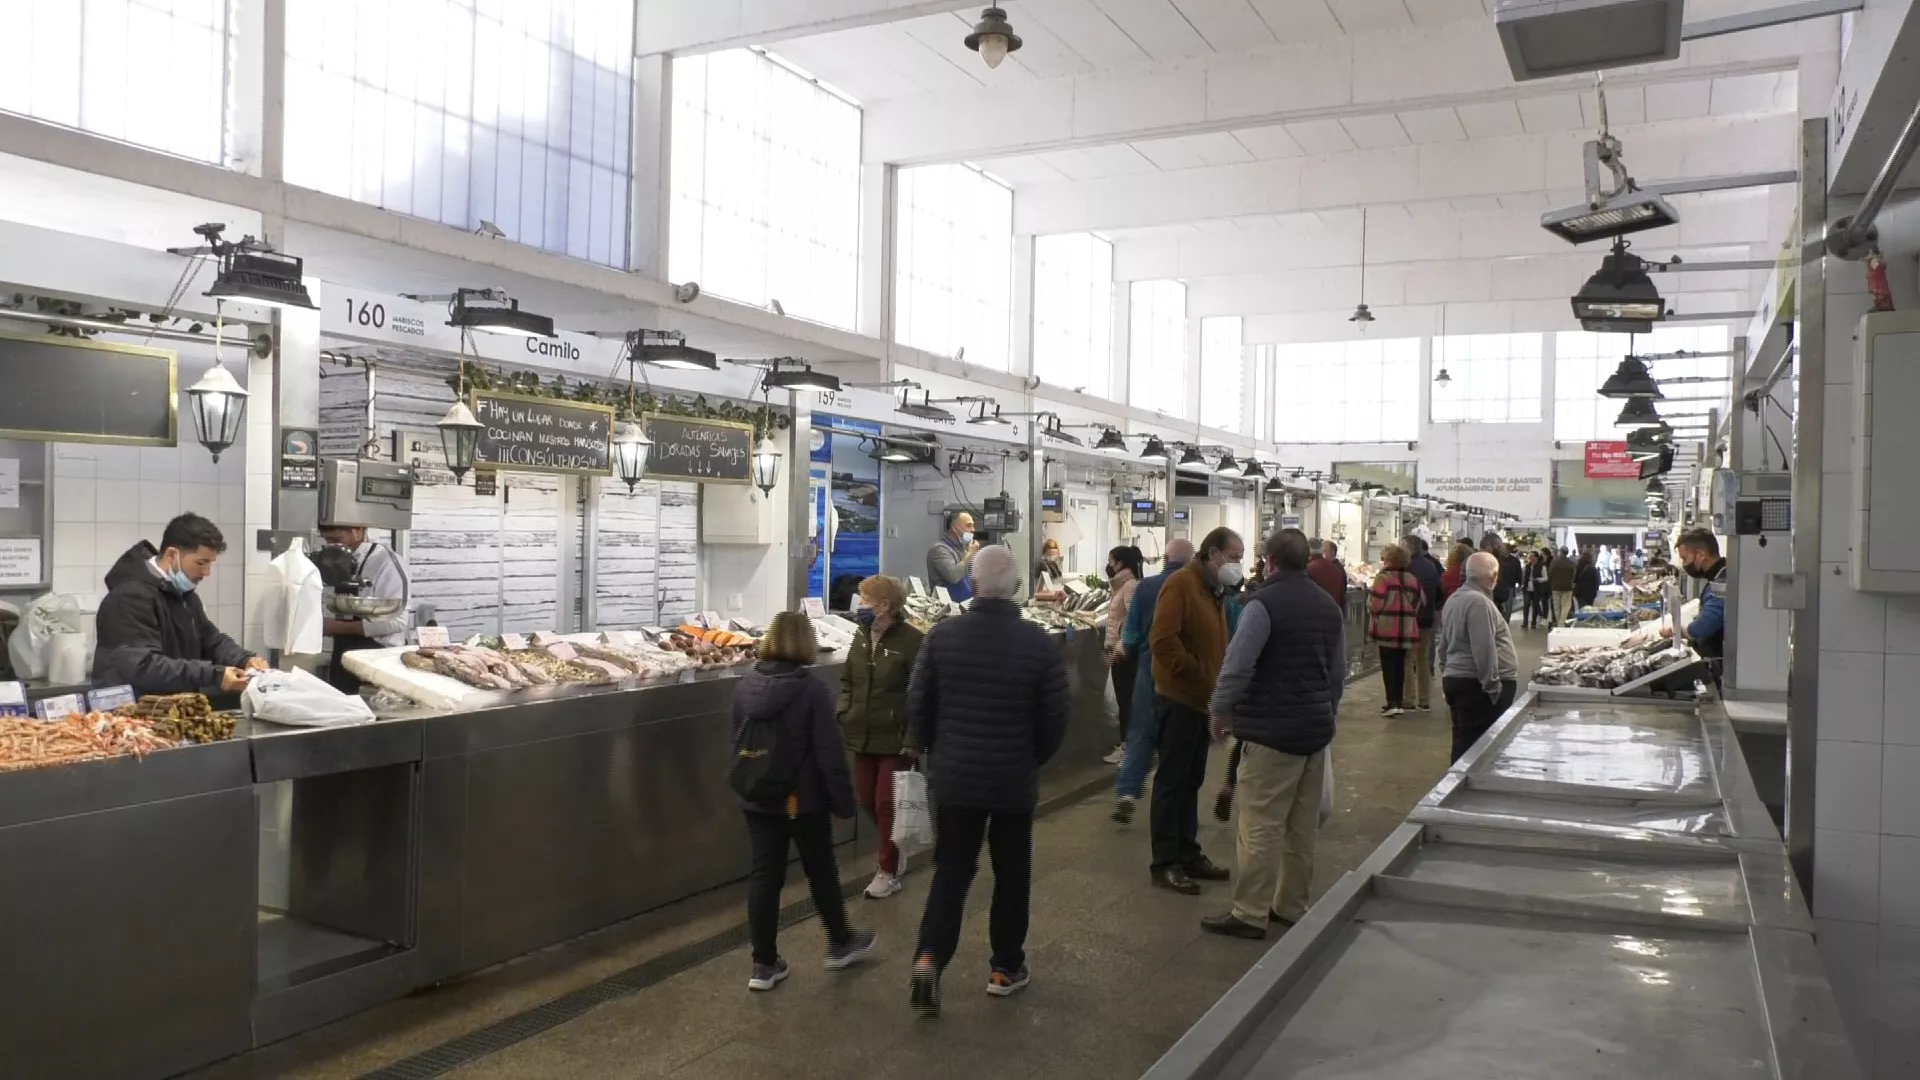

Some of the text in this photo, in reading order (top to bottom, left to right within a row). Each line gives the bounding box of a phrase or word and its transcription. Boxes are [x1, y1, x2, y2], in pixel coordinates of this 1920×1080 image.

[346, 298, 385, 329] 160
[392, 316, 424, 328] MARISCOS
[392, 324, 424, 336] PESCADOS
[526, 336, 580, 361] Camilo
